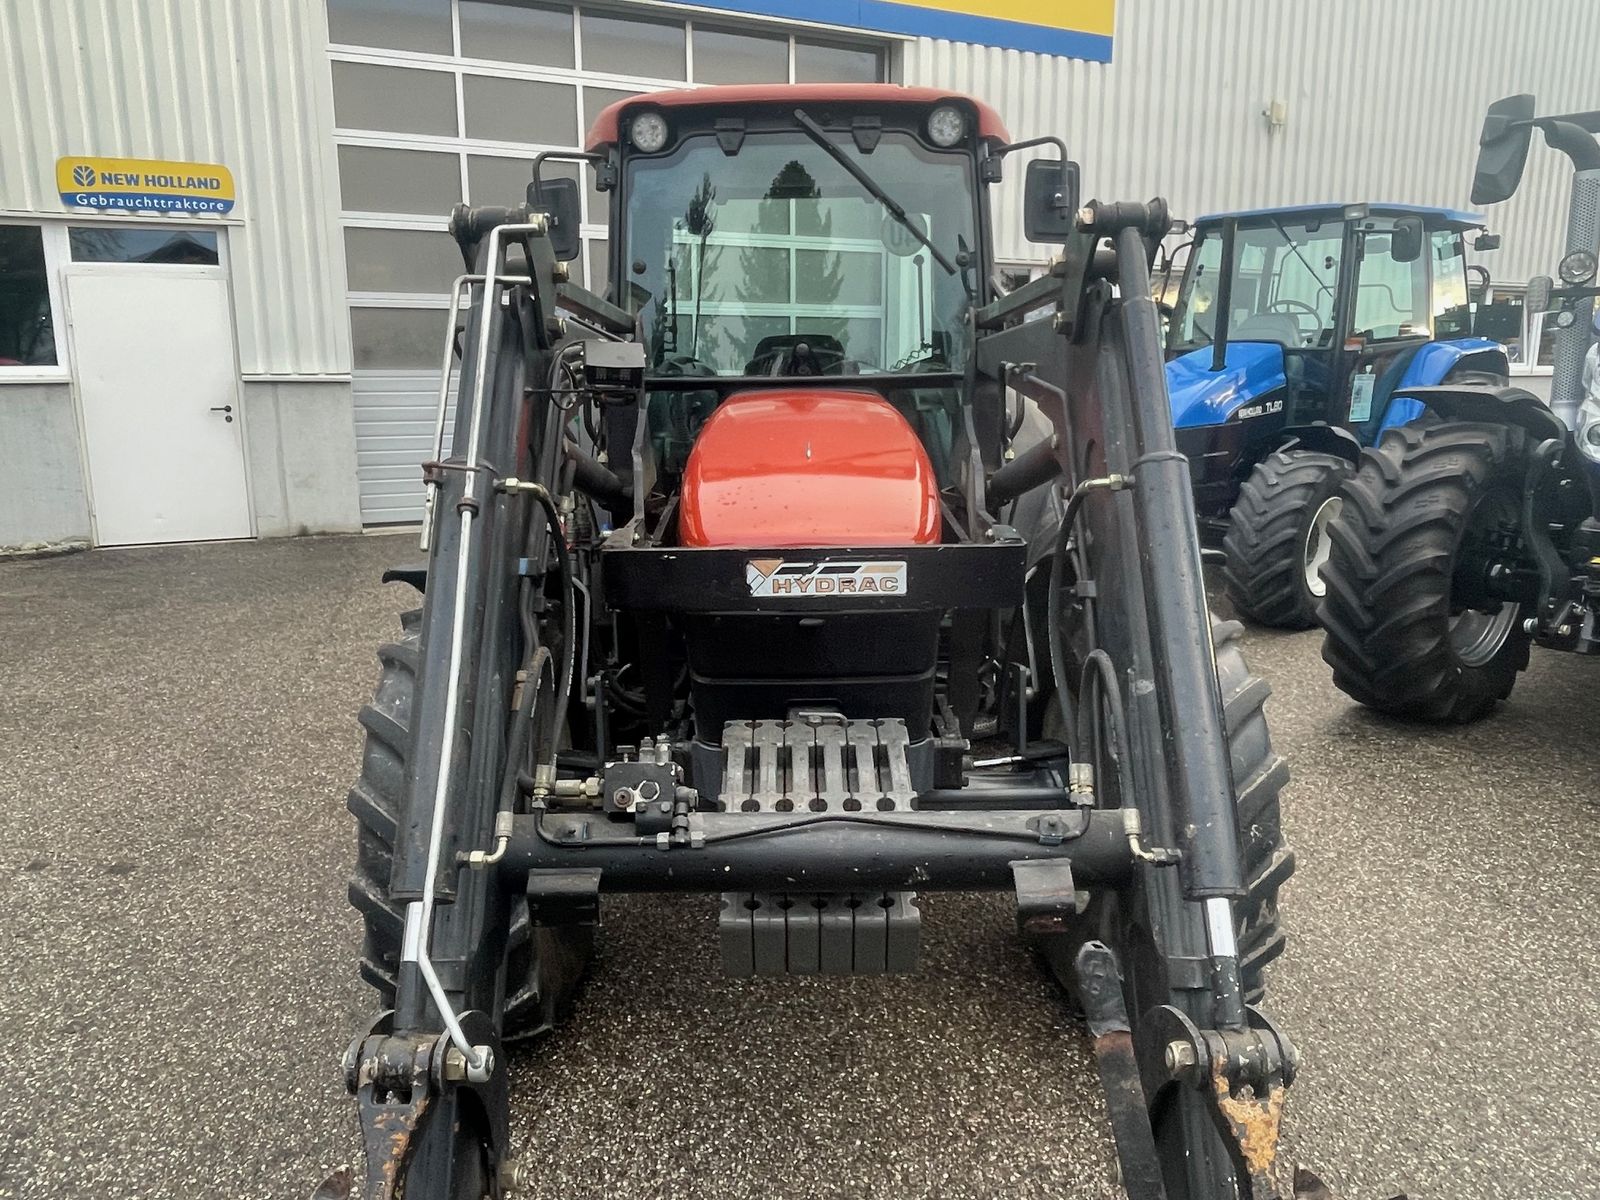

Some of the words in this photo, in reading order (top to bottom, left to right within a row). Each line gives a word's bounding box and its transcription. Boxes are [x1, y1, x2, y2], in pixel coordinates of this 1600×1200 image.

[101, 172, 140, 187] NEW
[144, 174, 221, 190] HOLLAND
[76, 193, 225, 211] Gebrauchttraktore
[772, 576, 899, 594] HYDRAC
